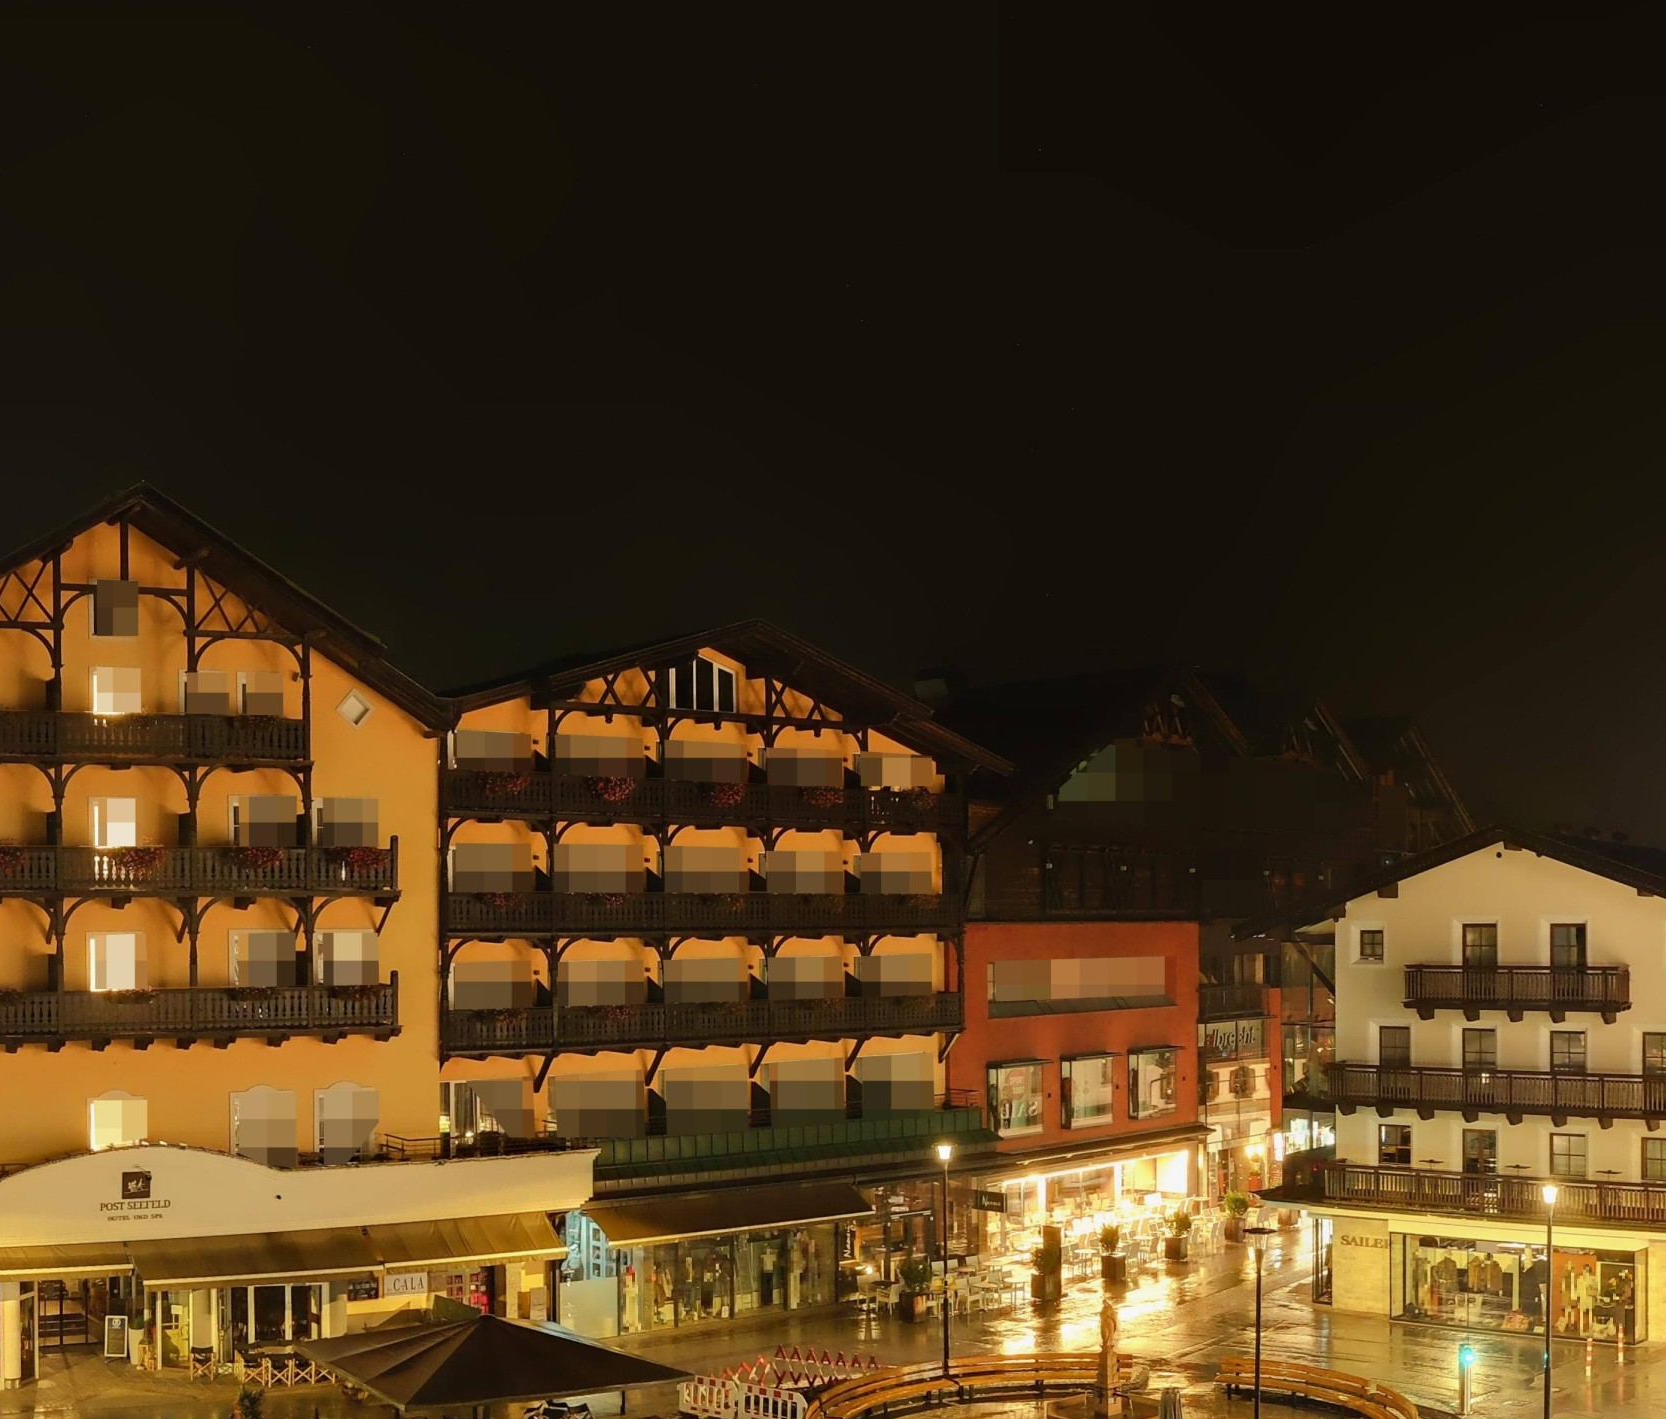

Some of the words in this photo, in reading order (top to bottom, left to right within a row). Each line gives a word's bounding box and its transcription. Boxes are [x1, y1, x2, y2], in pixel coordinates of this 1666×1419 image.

[100, 1201, 125, 1211] POST
[127, 1199, 171, 1210] SEEFELD
[393, 1276, 424, 1292] CALA
